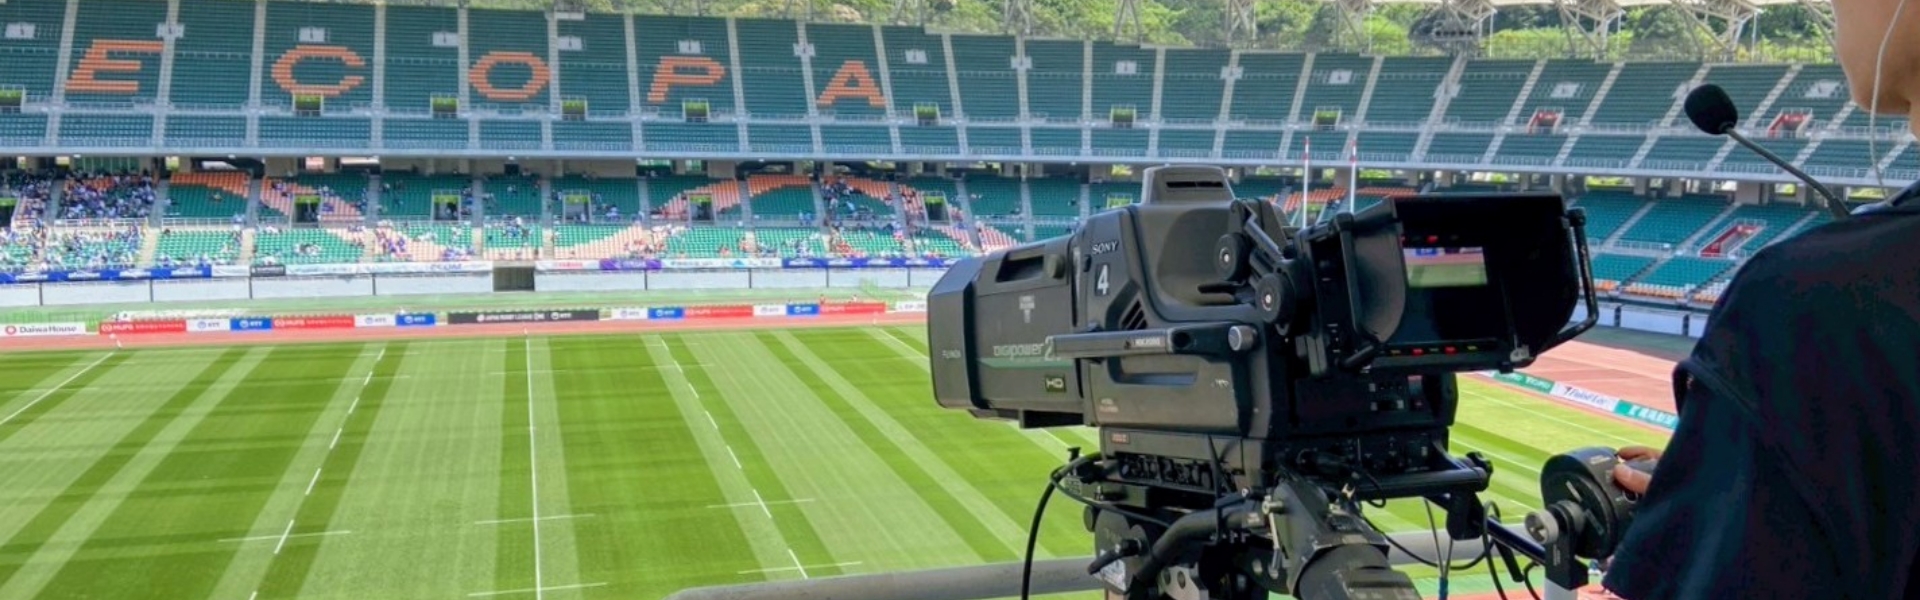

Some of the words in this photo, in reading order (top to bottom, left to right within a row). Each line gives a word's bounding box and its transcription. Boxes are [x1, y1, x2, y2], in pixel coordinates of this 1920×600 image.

[65, 39, 886, 107] ECOPA
[1092, 240, 1119, 254] SONY
[1097, 264, 1109, 295] 4
[1046, 378, 1064, 389] HD
